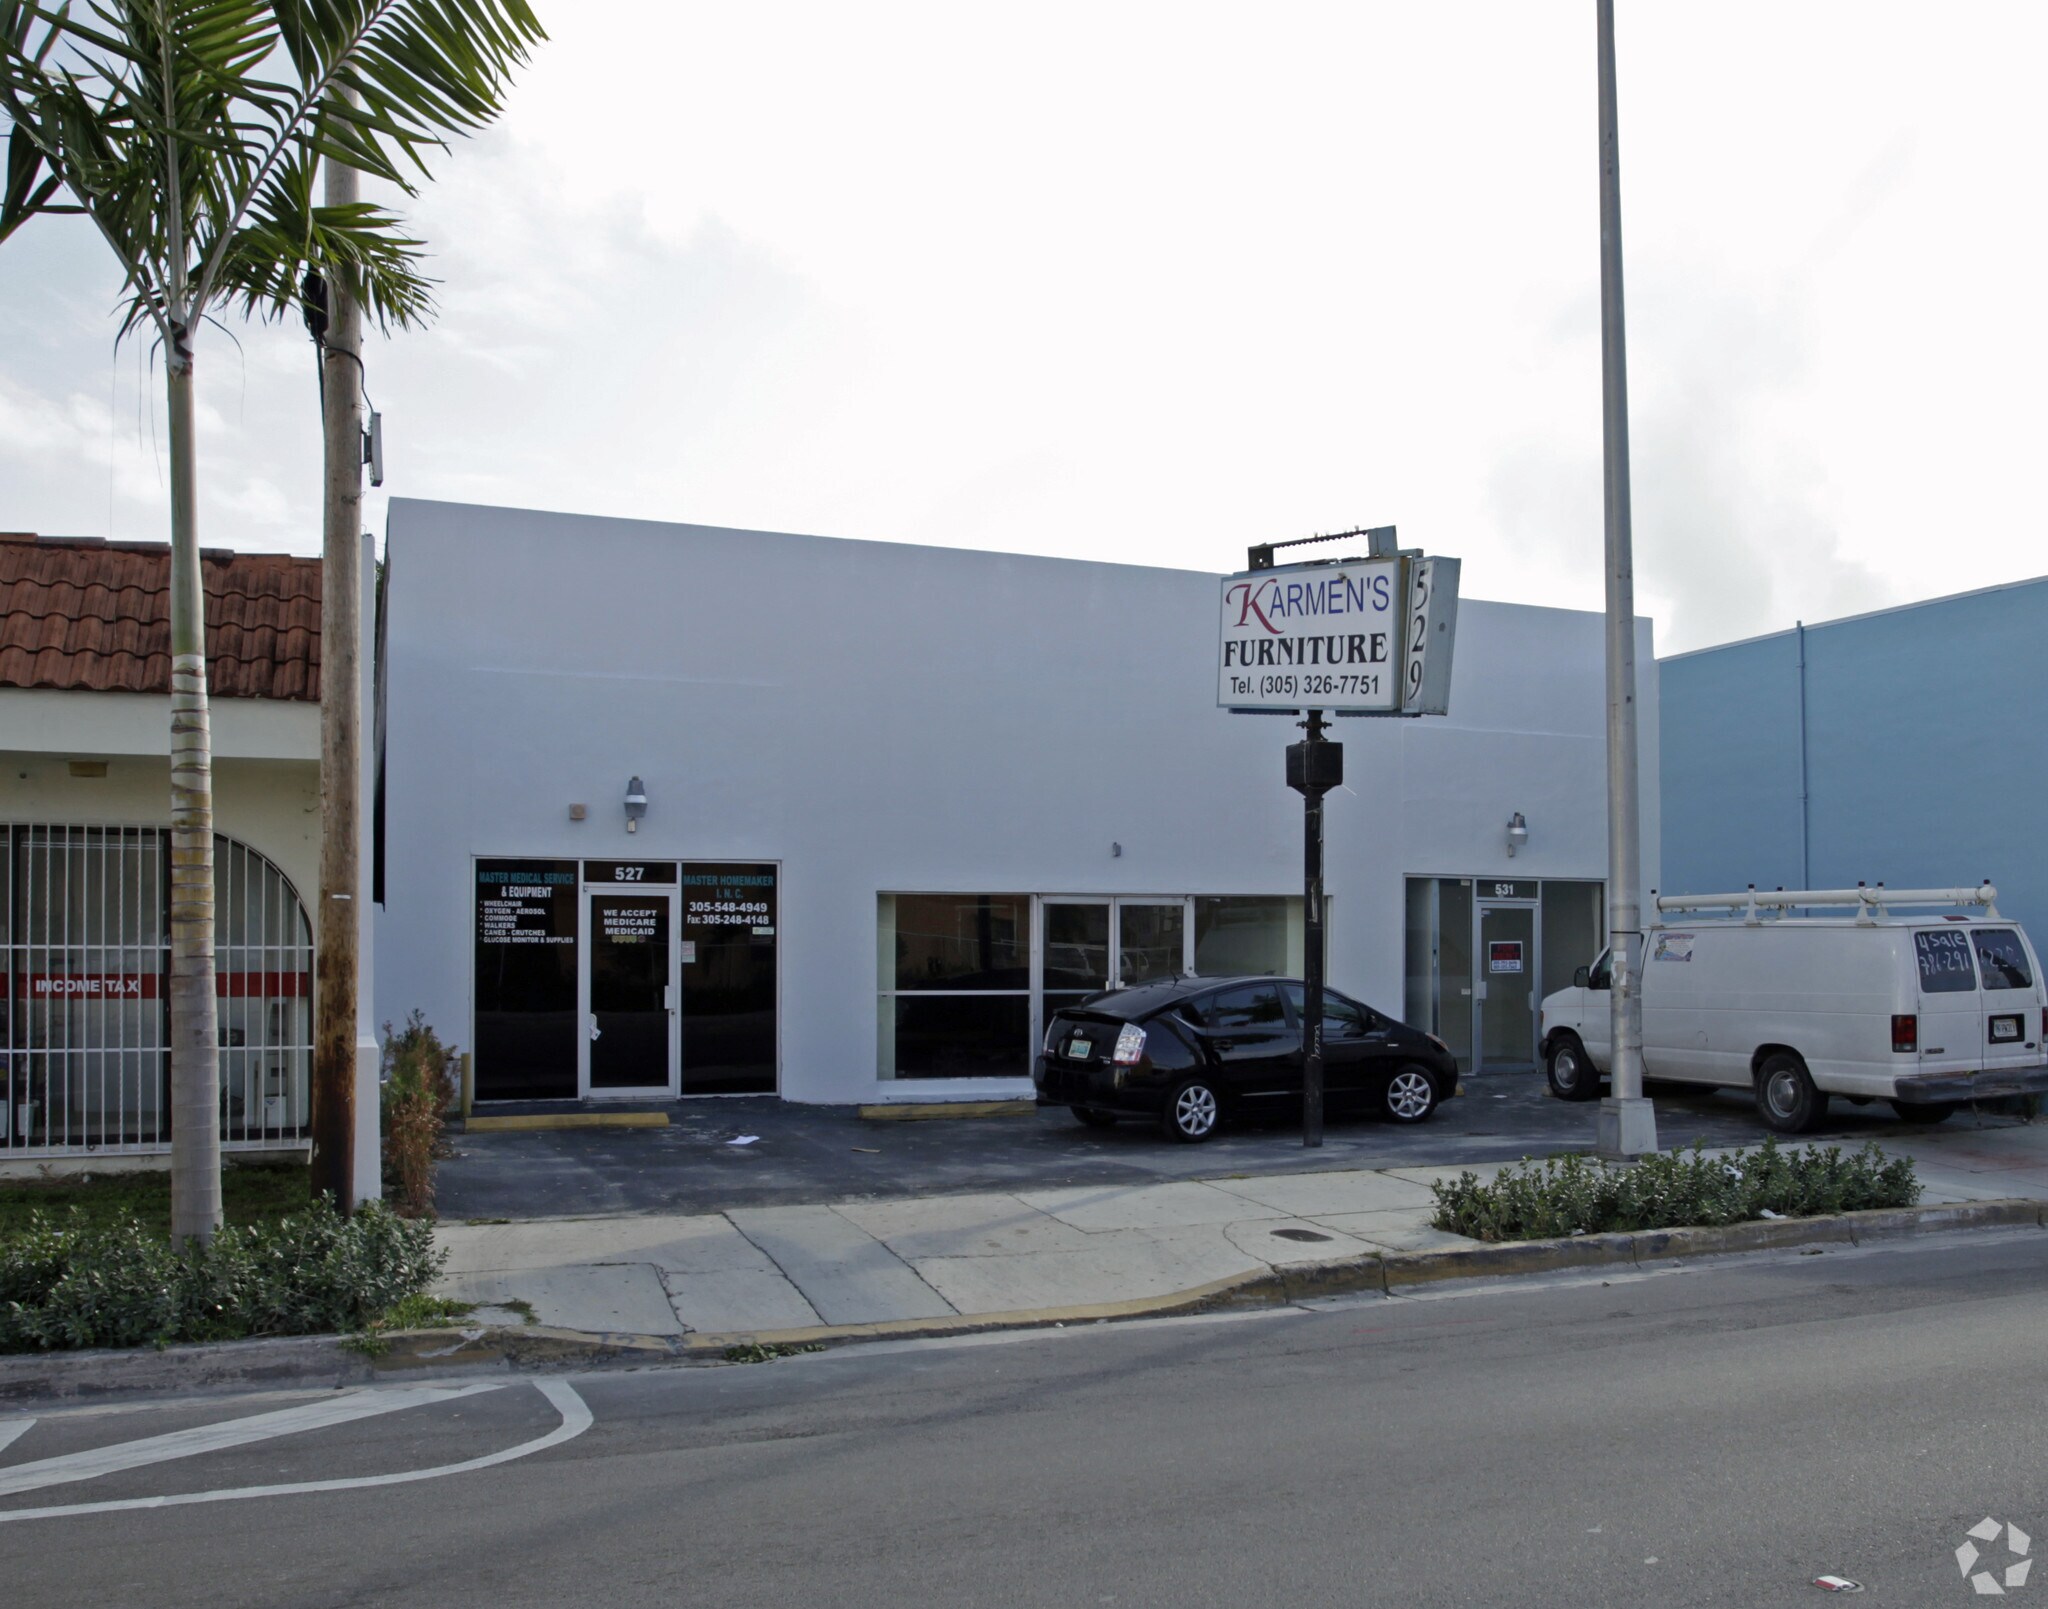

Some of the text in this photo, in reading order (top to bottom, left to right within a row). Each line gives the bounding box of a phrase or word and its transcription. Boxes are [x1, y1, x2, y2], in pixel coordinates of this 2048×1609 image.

[1225, 575, 1390, 635] KARMEN'S
[1408, 569, 1430, 701] 529
[1224, 632, 1389, 668] FURNITURE
[1230, 675, 1380, 698] Tel. (305) 326-7751
[479, 872, 575, 884] MASTER MEDICAL SERVICE
[615, 867, 645, 881] 527
[683, 875, 774, 886] MASTER HOMEMAKER
[501, 886, 552, 898] & EQUIPMENT
[1495, 883, 1514, 895] 531
[603, 909, 658, 917] WE ACCEPT
[689, 902, 768, 912] 305-548-4949
[603, 918, 657, 926] MEDICARE
[605, 927, 655, 935] MEDICAID
[35, 979, 139, 992] INCOME TAX
